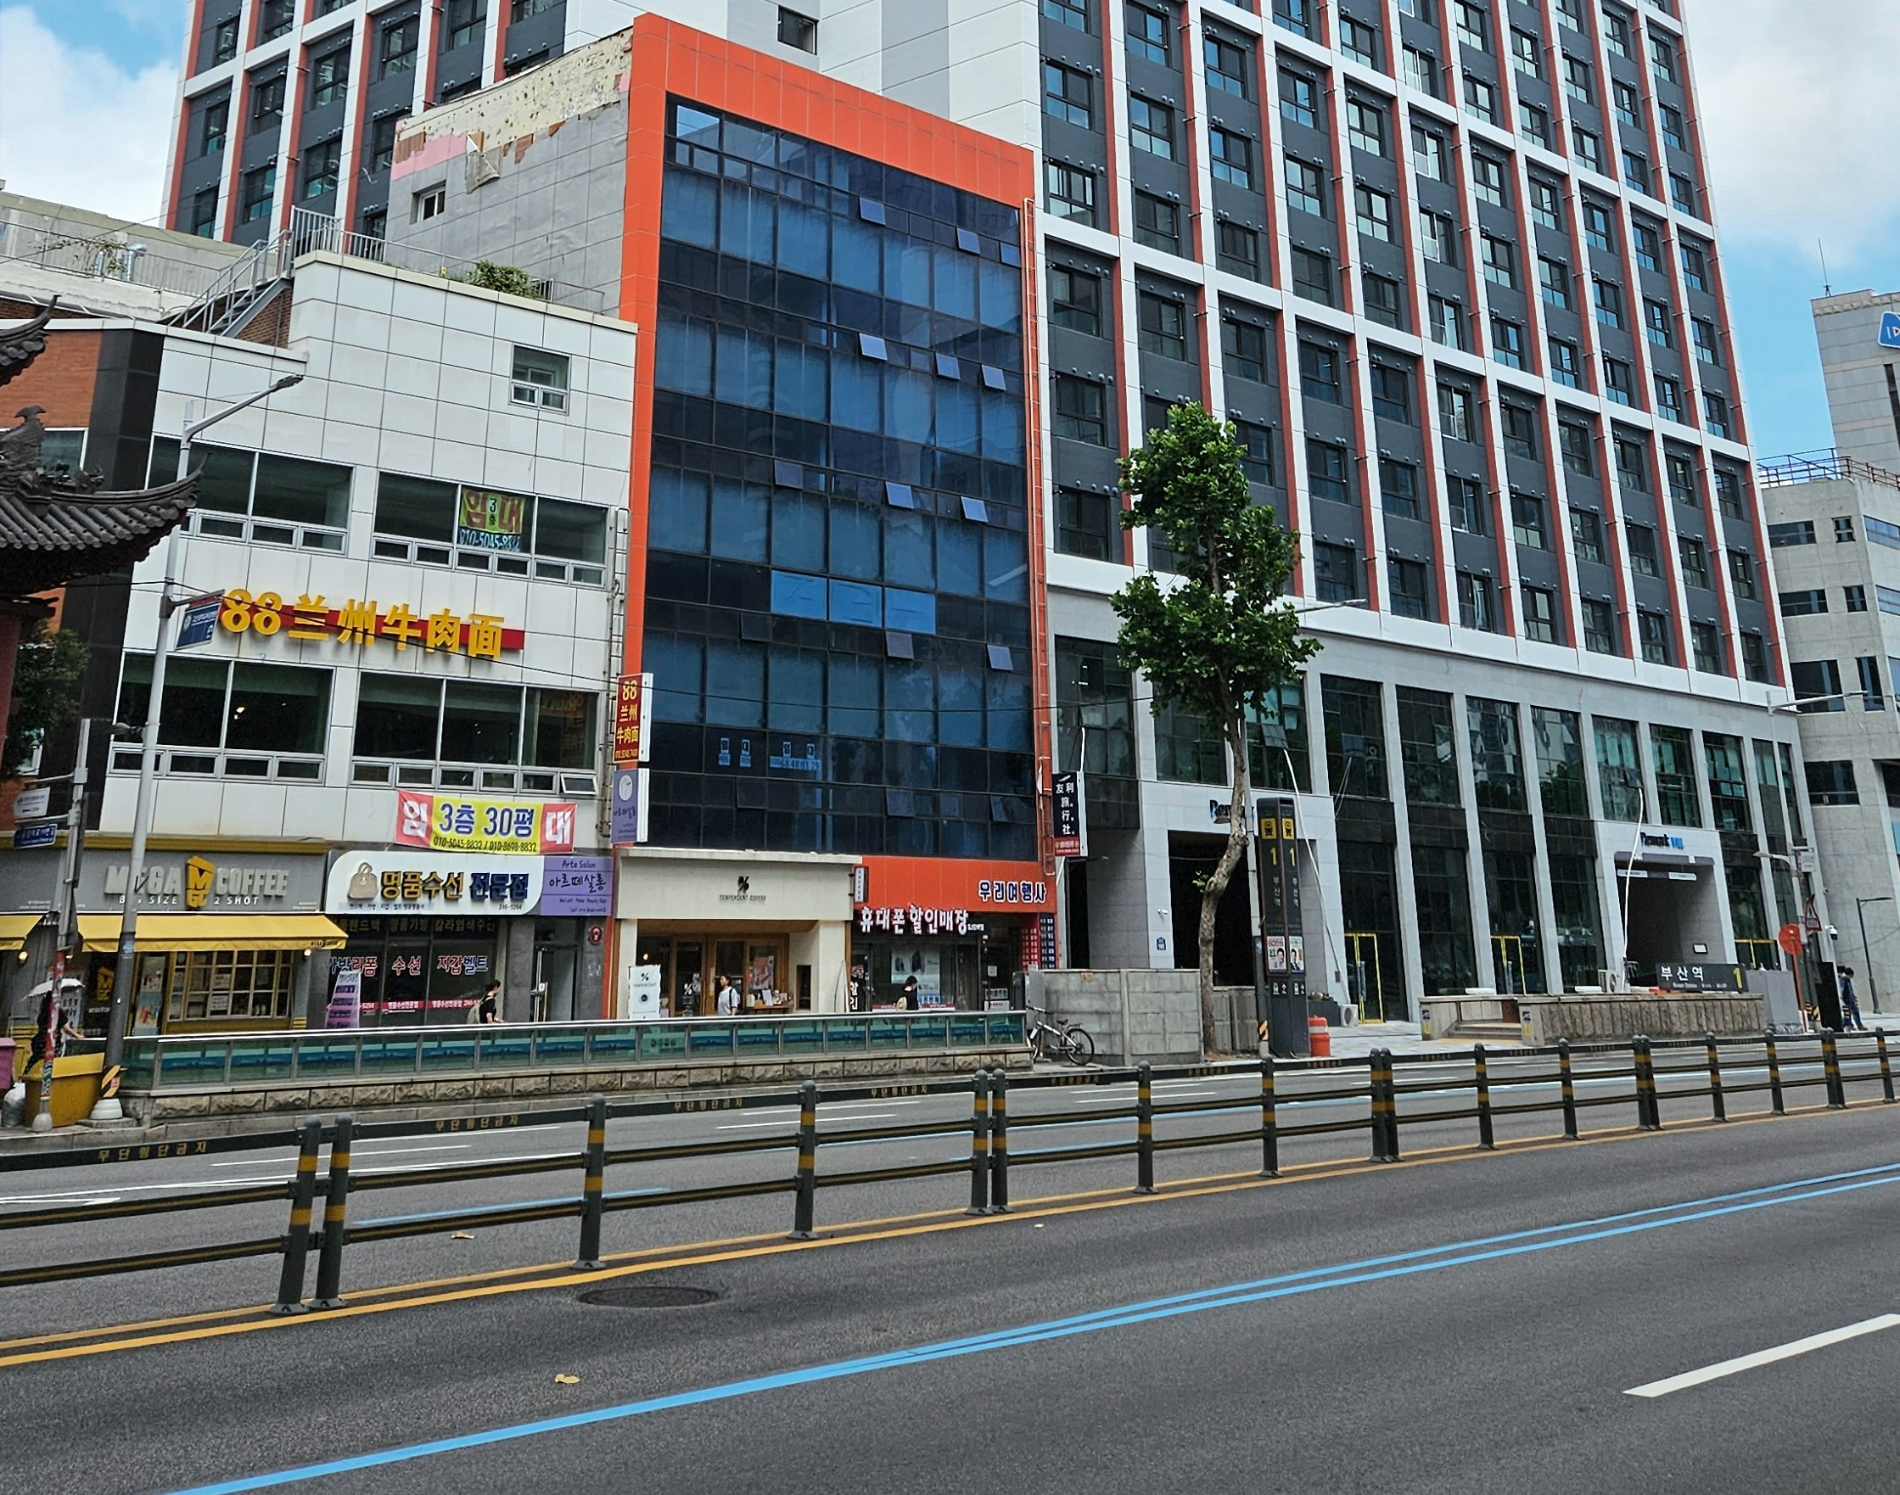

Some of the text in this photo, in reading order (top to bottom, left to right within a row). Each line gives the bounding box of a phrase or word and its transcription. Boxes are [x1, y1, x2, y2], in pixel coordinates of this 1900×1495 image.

[221, 589, 505, 659] 88兰州牛肉面
[622, 680, 638, 701] 88
[620, 704, 637, 722] 兰州
[402, 800, 571, 845] 임 3층 30평 대
[562, 859, 578, 869] Arte
[1269, 847, 1277, 866] 1
[1289, 848, 1296, 867] 1
[215, 867, 289, 896] COFFEE
[381, 870, 530, 900] 명품수선 전문점
[549, 873, 607, 894] 아르떼살롱
[978, 880, 1047, 903] 우리여행사
[148, 896, 178, 904] SIZE
[214, 896, 220, 905] 2
[226, 896, 259, 905] SHOT
[860, 903, 969, 936] 휴대폰 할인매장
[437, 955, 489, 977] 지갑벨트
[1660, 966, 1743, 989] 부산역 1
[98, 1140, 207, 1163] 무단횡단금지
